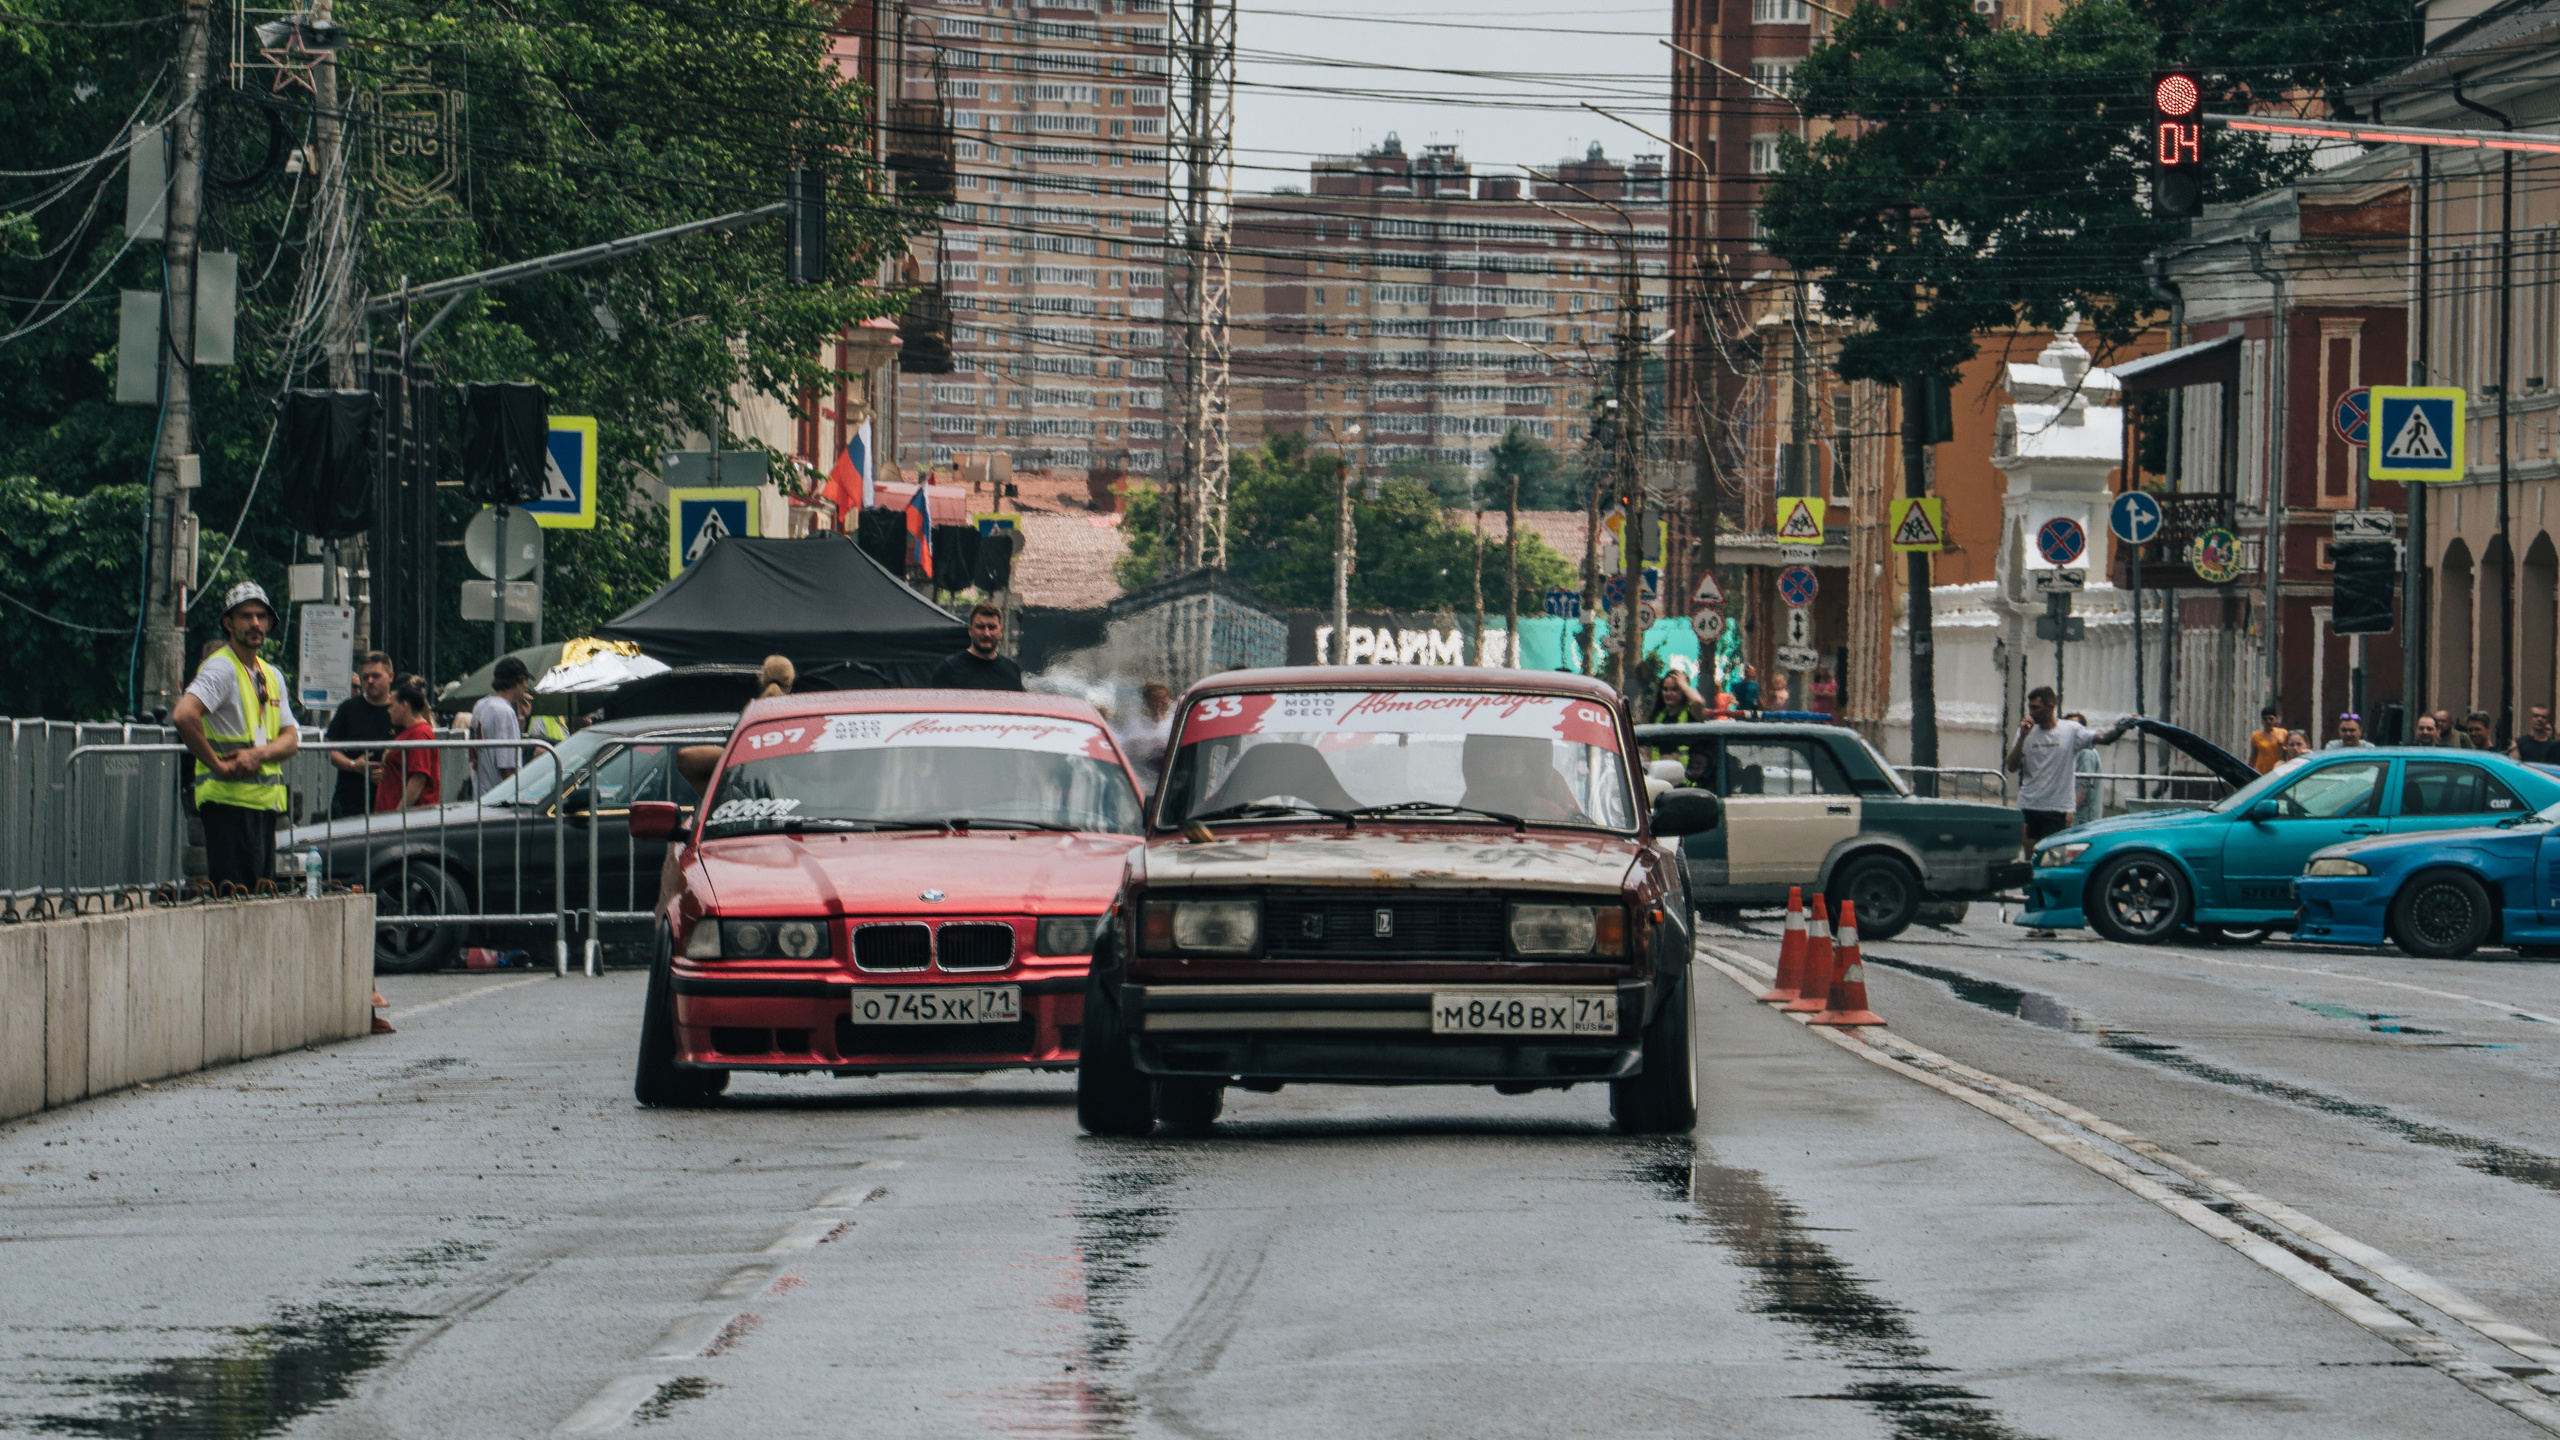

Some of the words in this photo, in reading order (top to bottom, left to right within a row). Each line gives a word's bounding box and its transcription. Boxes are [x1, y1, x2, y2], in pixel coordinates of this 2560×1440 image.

[2160, 122, 2199, 164] 04
[1198, 694, 1243, 722] 33
[1284, 708, 1335, 717] ФЕСТ
[1285, 698, 1335, 707] МОТО
[1578, 708, 1613, 728] au
[748, 727, 806, 750] 197
[863, 994, 975, 1021] О745ХК
[983, 990, 1010, 1012] 71
[981, 1011, 1001, 1020] RUS
[1445, 1000, 1567, 1030] М848ВХ
[1576, 999, 1606, 1022] 71
[1575, 1022, 1597, 1032] RUS
